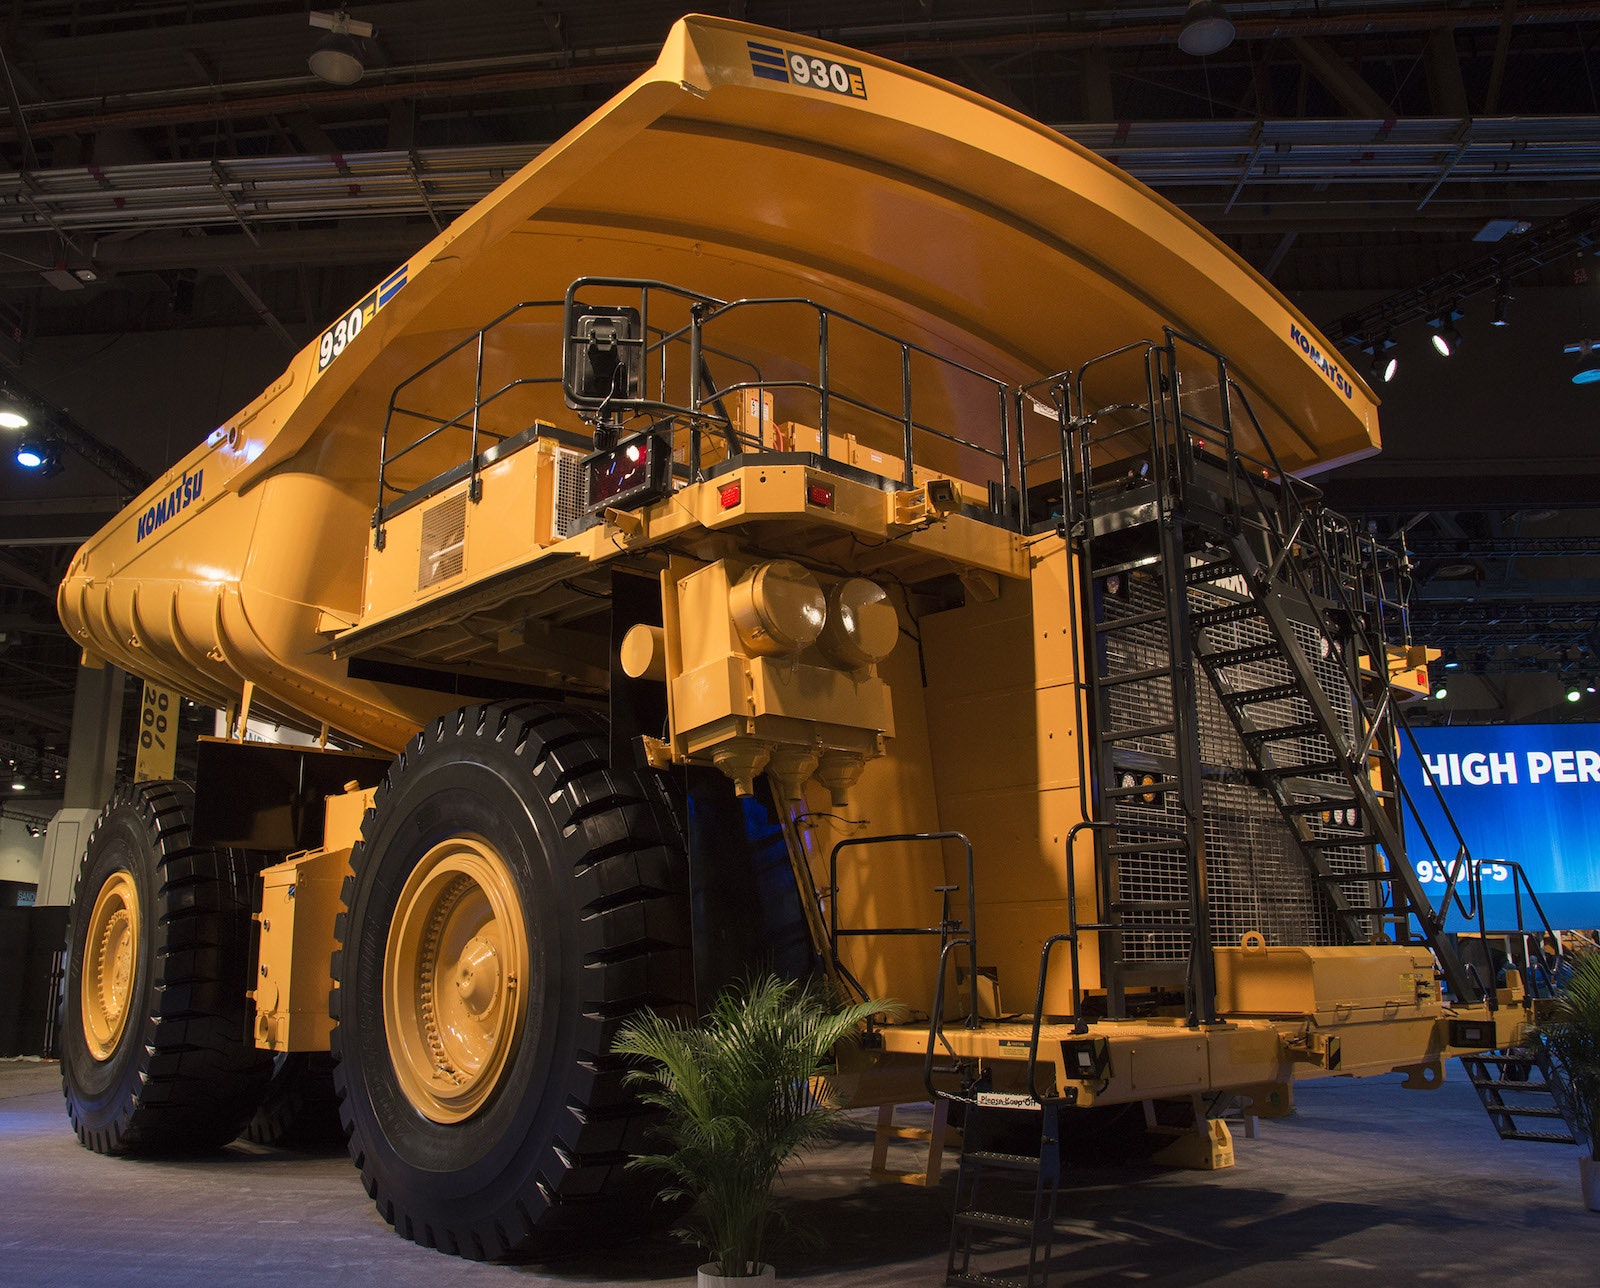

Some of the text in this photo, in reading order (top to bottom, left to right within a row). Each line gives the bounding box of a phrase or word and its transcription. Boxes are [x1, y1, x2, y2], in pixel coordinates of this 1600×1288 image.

[790, 54, 865, 97] 930E
[1290, 323, 1352, 399] KOMATSU
[136, 468, 204, 543] KOMATSU
[141, 686, 156, 749] 200
[1422, 750, 1600, 786] HIGH PER
